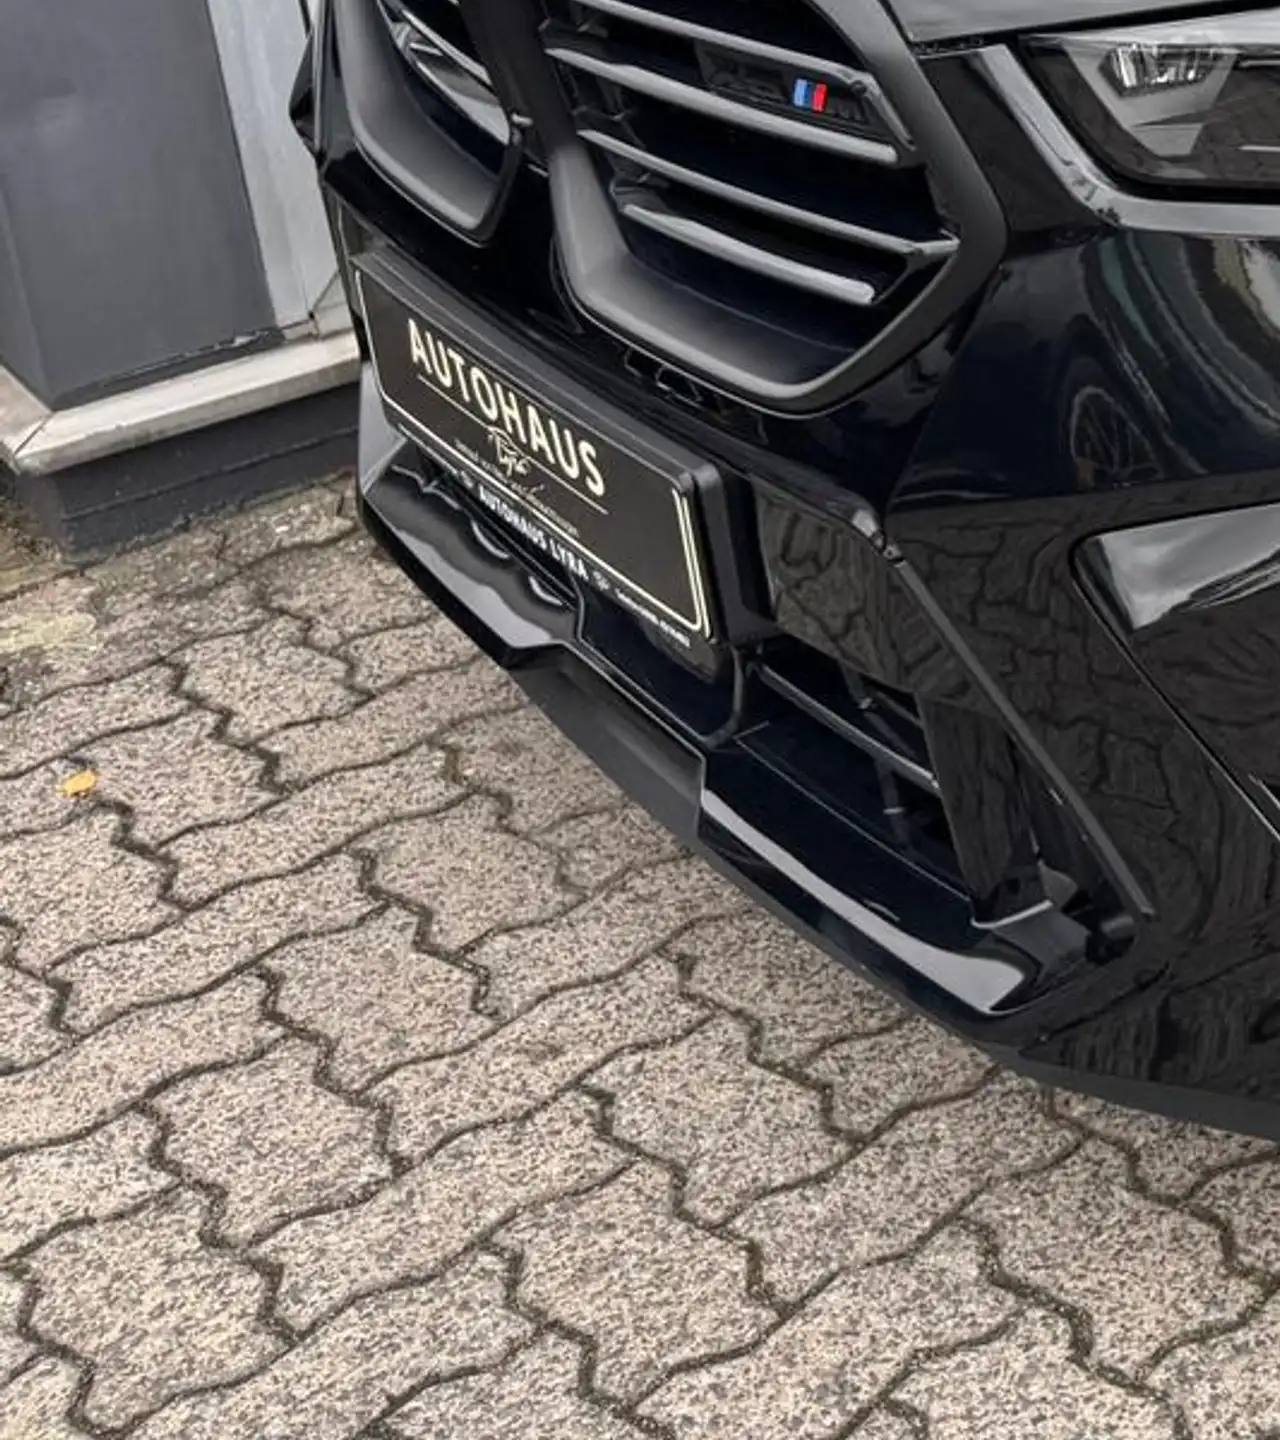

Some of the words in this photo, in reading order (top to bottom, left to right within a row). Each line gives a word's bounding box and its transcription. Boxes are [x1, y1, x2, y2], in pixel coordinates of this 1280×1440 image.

[408, 318, 606, 497] AUTOHAUS
[478, 485, 548, 549] AUTOHAUS
[551, 539, 590, 580] LYRA
